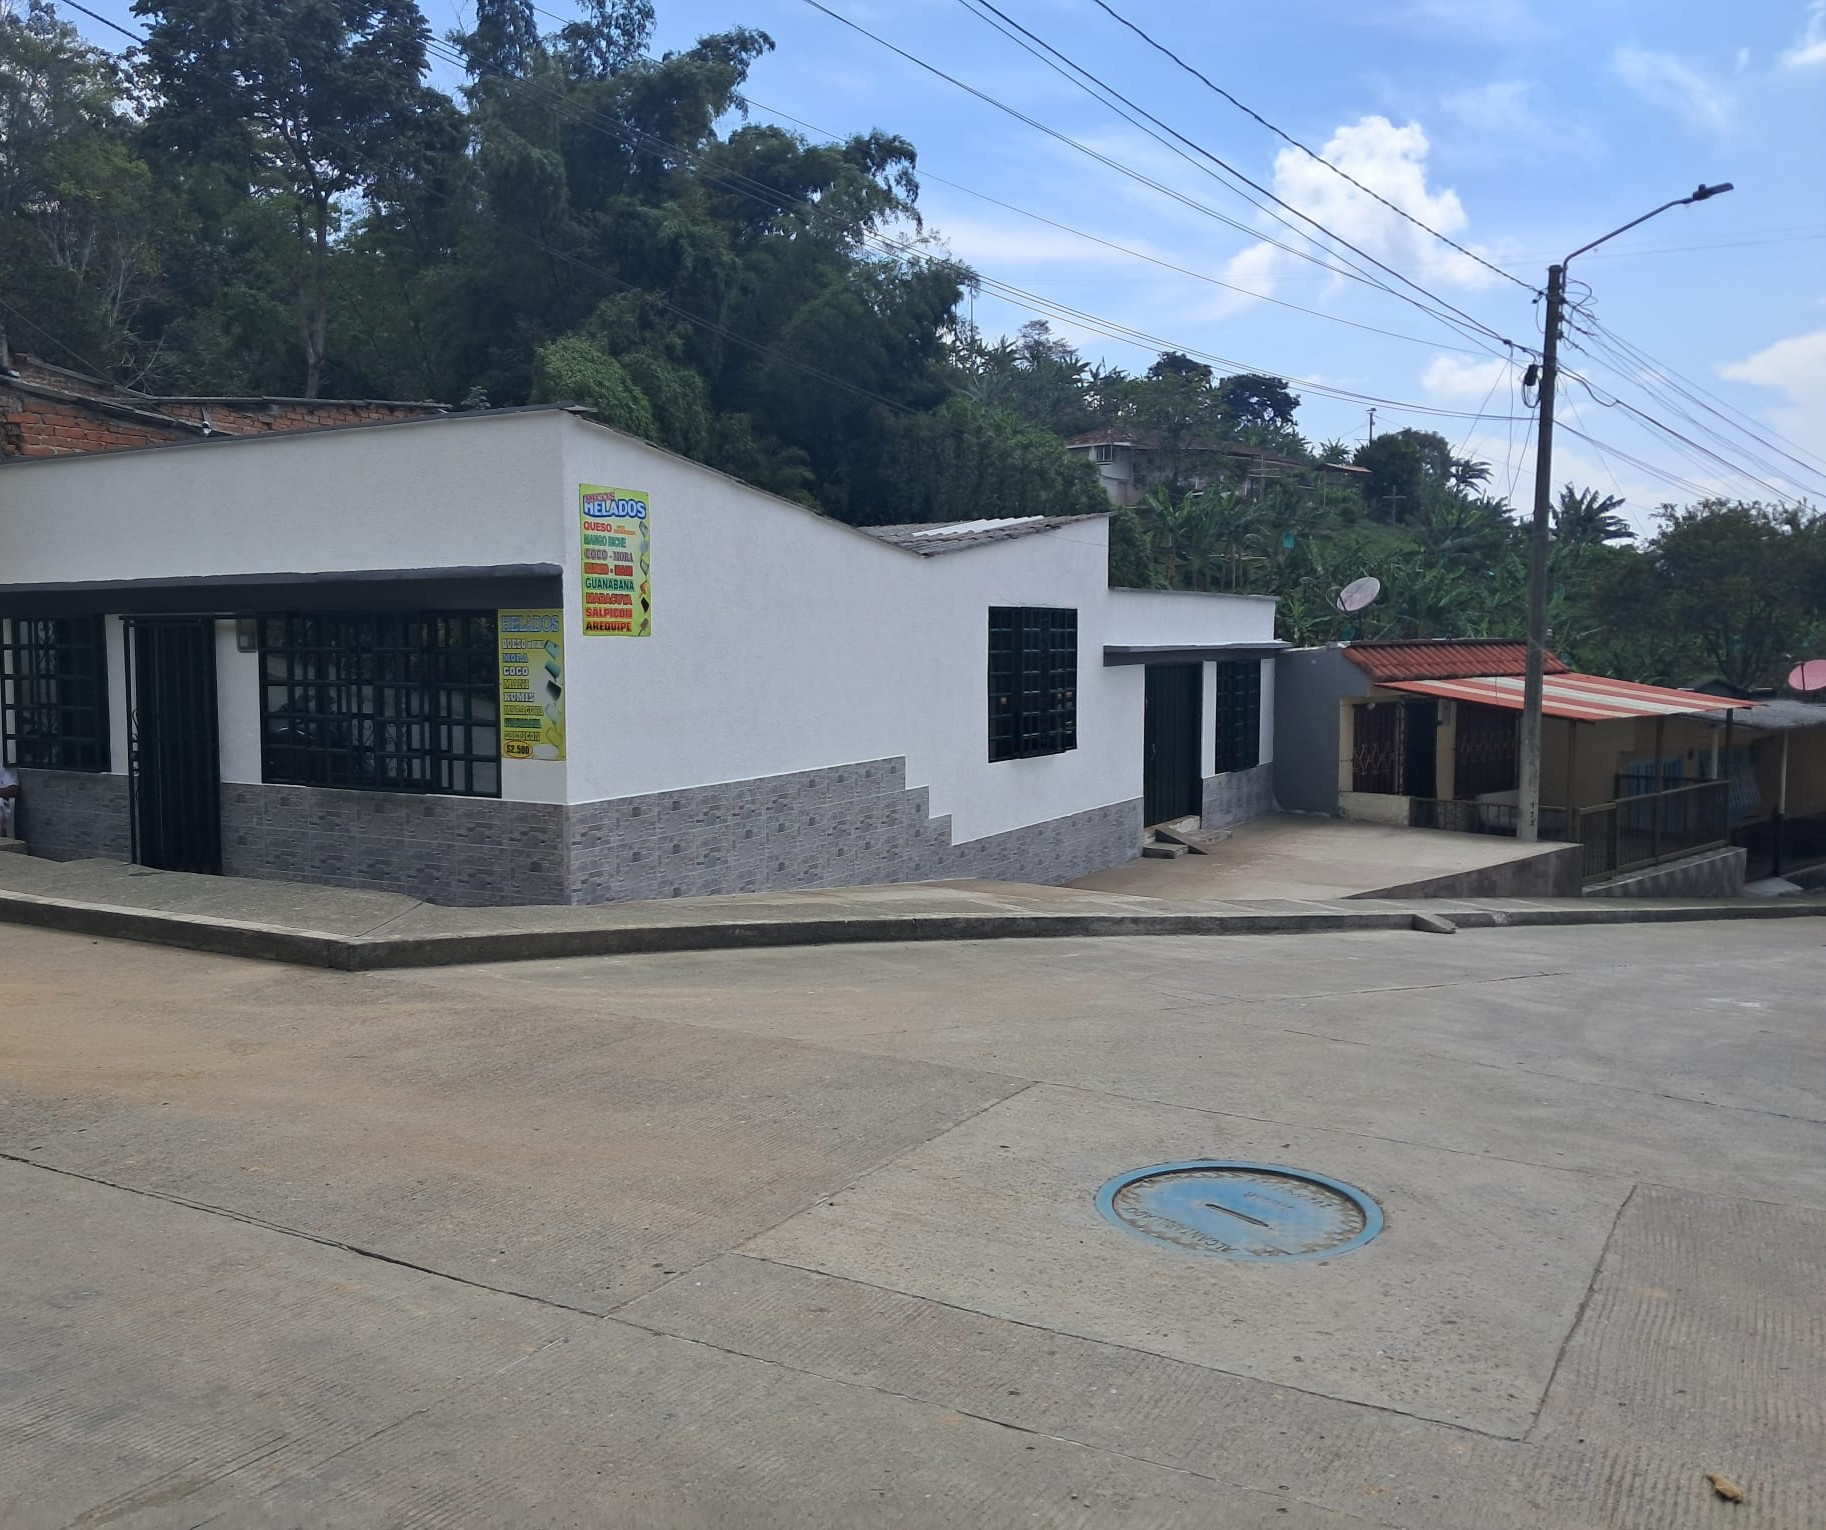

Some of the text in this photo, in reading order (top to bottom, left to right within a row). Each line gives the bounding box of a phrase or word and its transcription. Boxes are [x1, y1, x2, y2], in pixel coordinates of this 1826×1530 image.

[584, 499, 647, 520] HELADOS
[584, 521, 612, 532] QUESO
[585, 548, 608, 560] COCO
[613, 551, 634, 563] MORA
[585, 578, 635, 591] GUANABANA
[501, 615, 560, 632] HELADOS
[586, 621, 632, 633] AREQUIPE
[502, 638, 526, 649] QUESO
[503, 666, 529, 677] COCO
